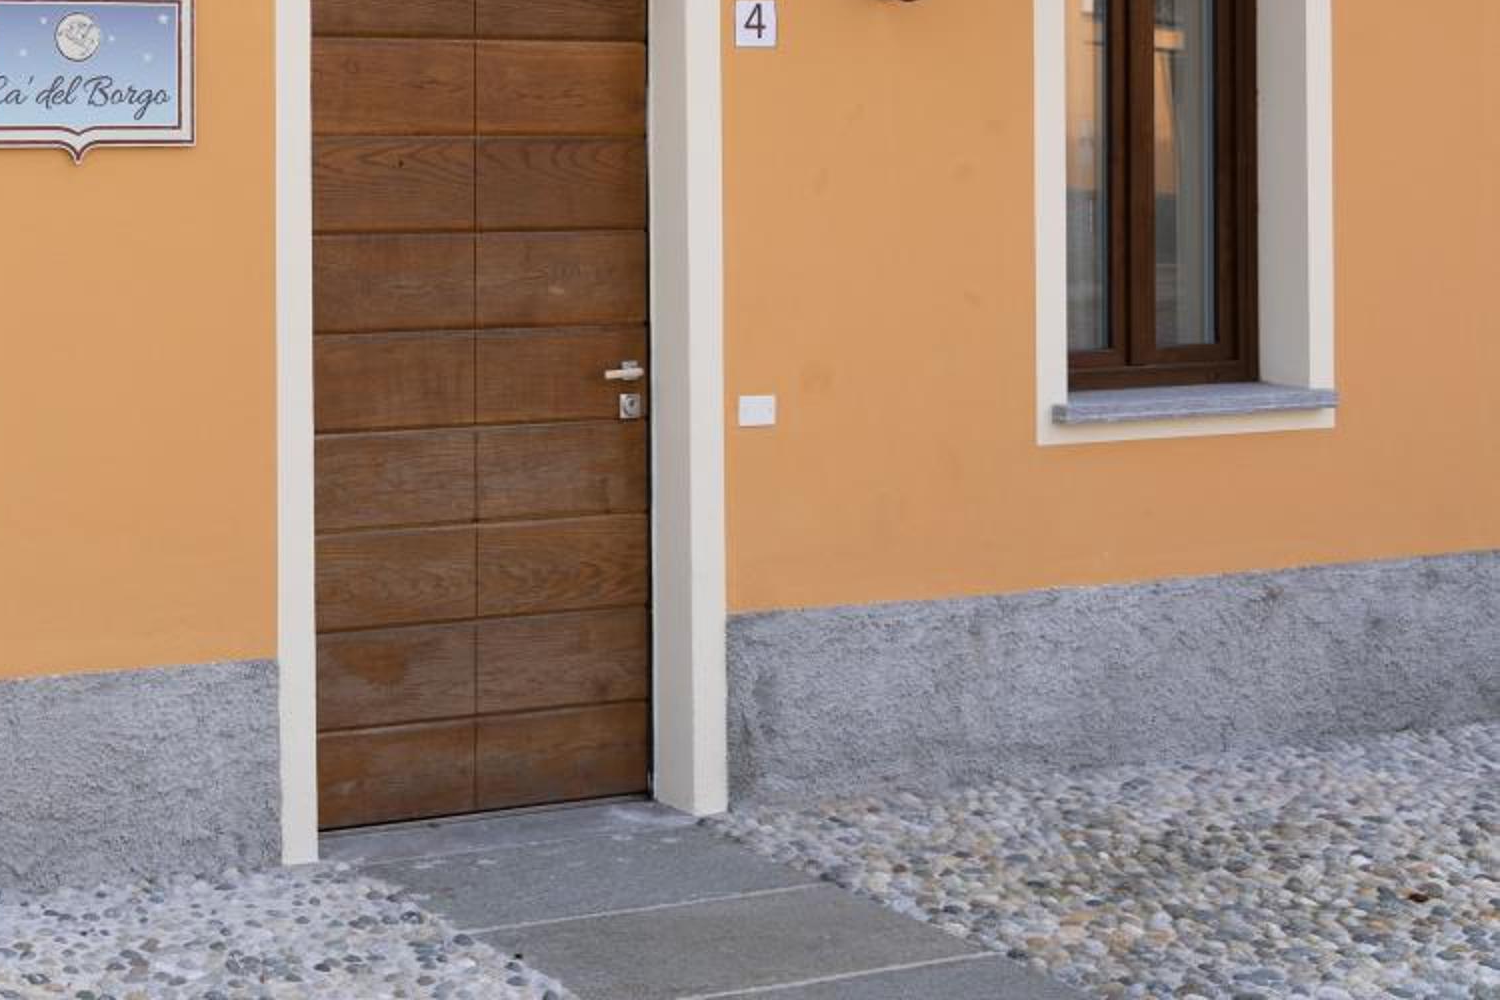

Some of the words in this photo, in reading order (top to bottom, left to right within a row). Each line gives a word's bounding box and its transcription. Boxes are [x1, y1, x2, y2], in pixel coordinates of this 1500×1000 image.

[743, 3, 767, 39] 4
[35, 75, 82, 110] del
[83, 75, 171, 121] Borgo
